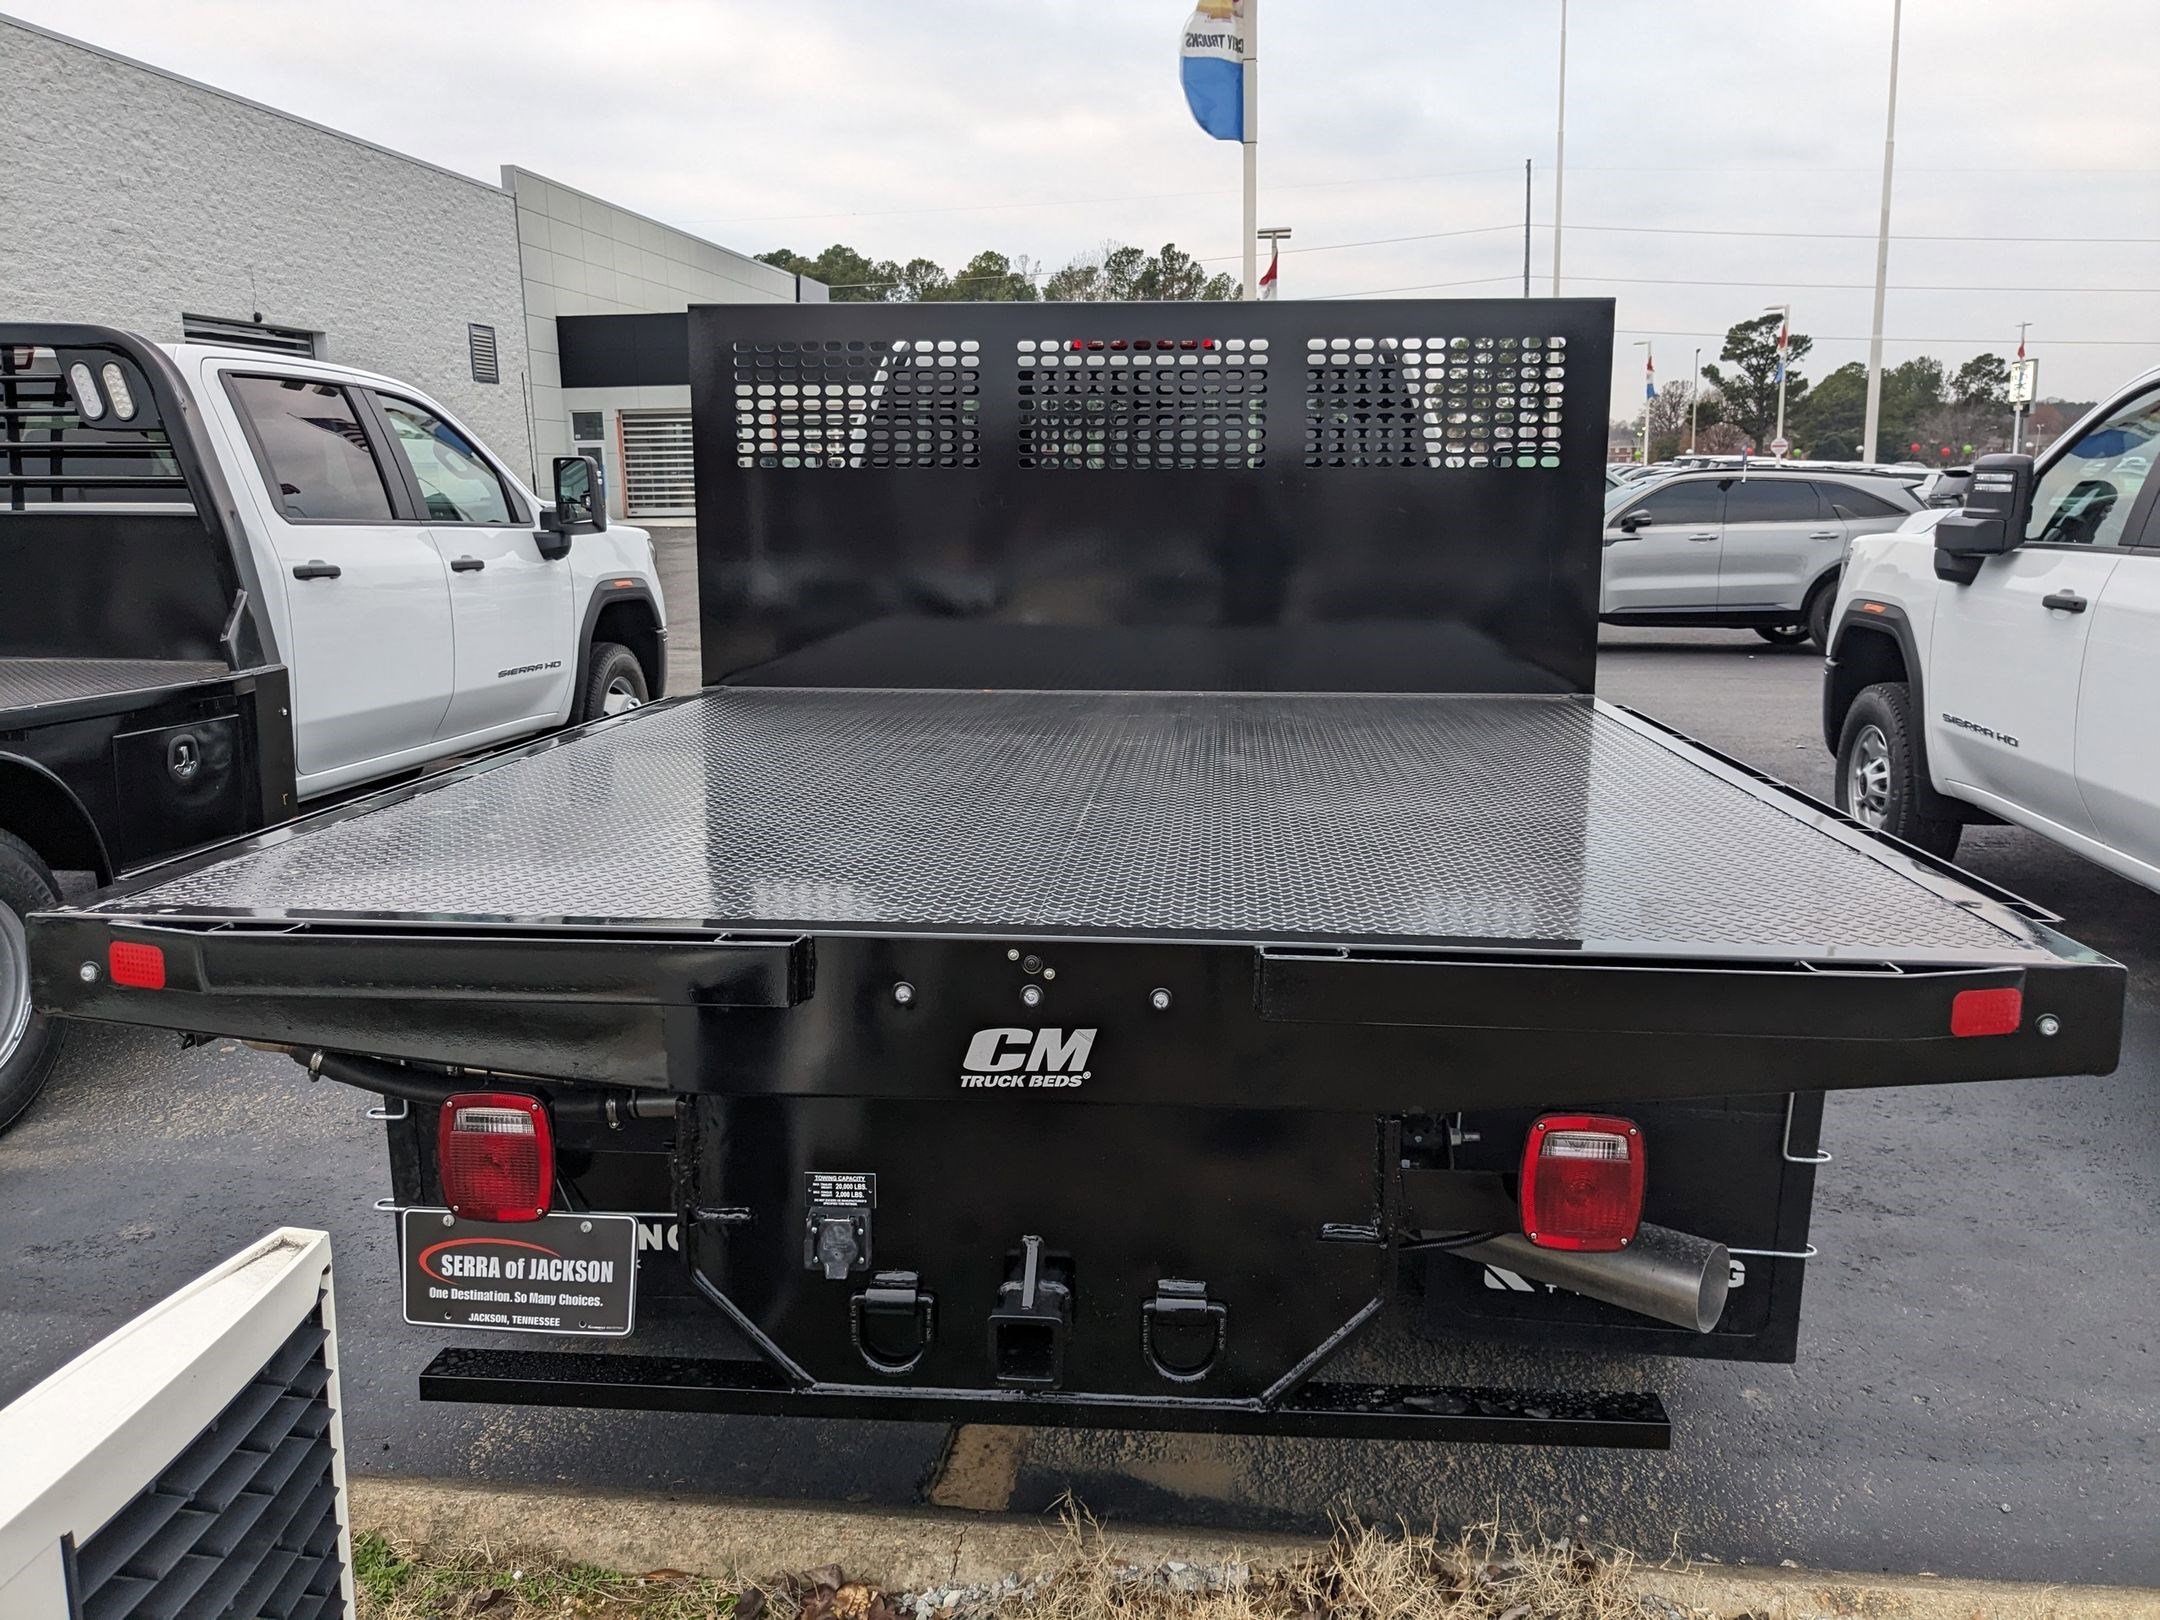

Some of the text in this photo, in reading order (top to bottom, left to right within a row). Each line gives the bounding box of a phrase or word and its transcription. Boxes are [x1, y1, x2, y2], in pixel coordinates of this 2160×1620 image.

[498, 661, 561, 678] SIERRA HD
[1942, 713, 2019, 747] SIERRA HD
[962, 1027, 1098, 1072] CM
[960, 1075, 1026, 1088] TRUCK
[441, 1254, 501, 1279] SERRA
[505, 1259, 525, 1279] of
[528, 1258, 614, 1283] JACKSON
[429, 1287, 604, 1307] One Destination. So Many Choices.
[468, 1313, 561, 1327] JACKSON, TENNESSEE
